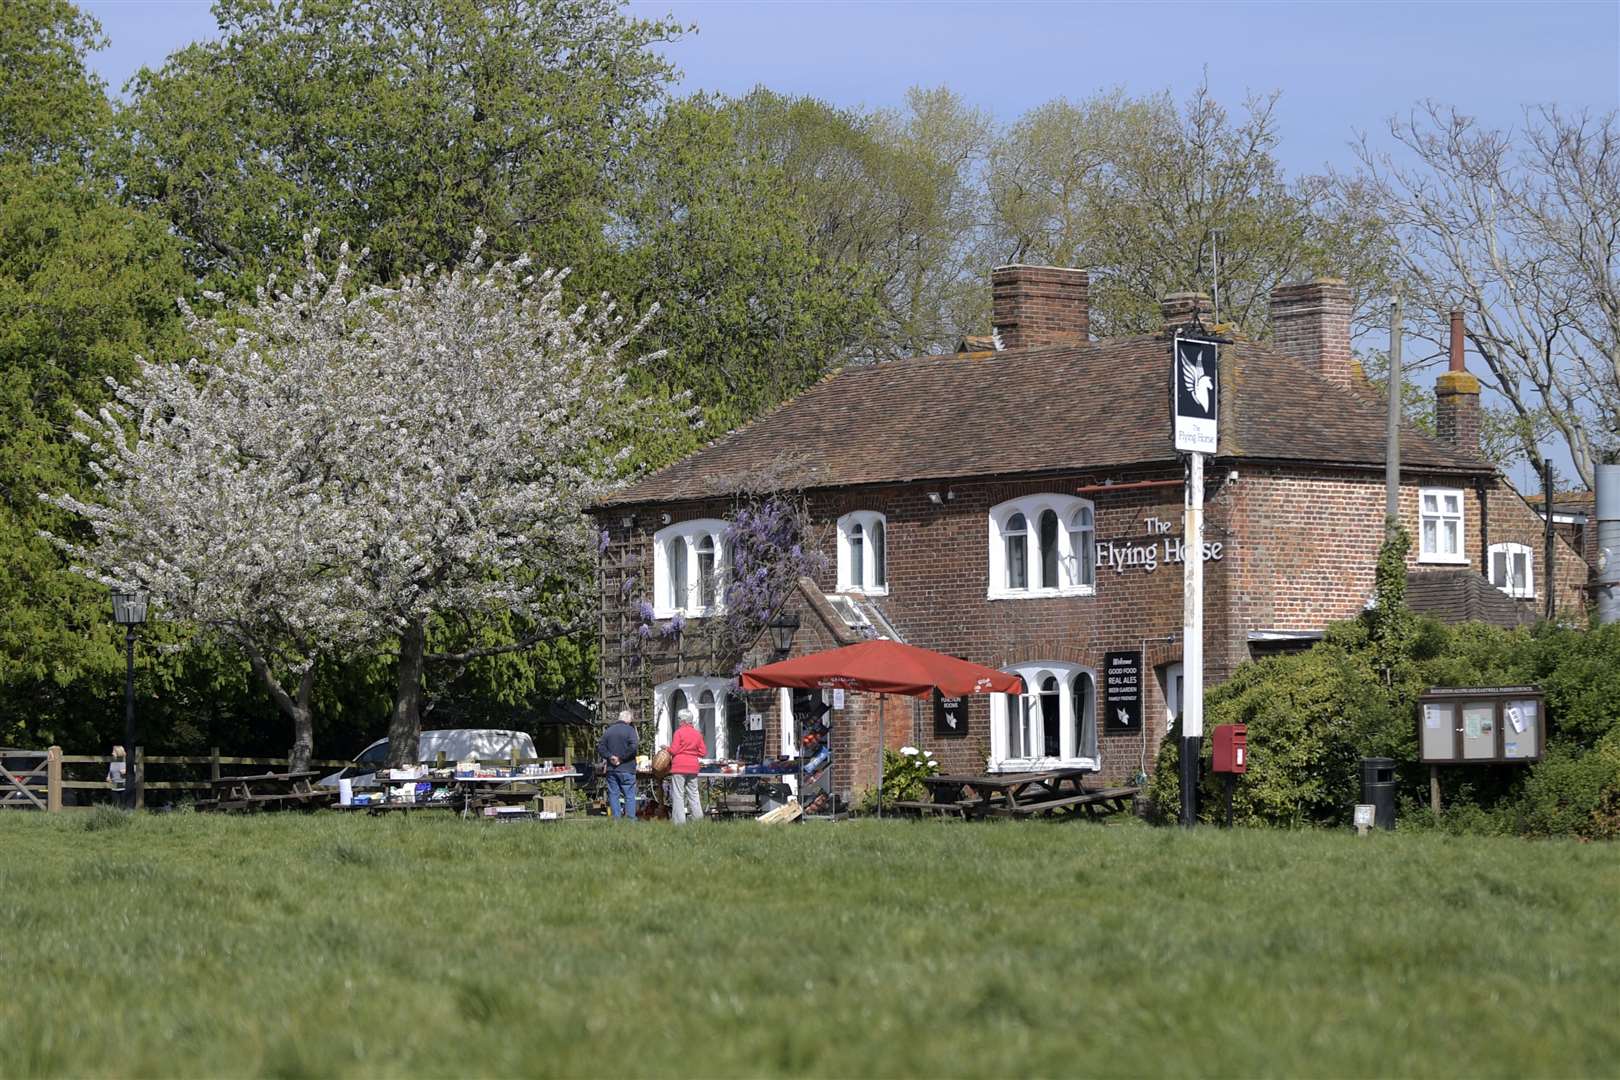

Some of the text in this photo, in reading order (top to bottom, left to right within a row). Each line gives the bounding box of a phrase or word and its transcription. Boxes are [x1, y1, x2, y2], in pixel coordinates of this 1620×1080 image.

[1178, 430, 1197, 444] Flying
[1144, 517, 1172, 534] The
[1095, 538, 1223, 572] Flying Hse
[1108, 676, 1122, 684] REAL
